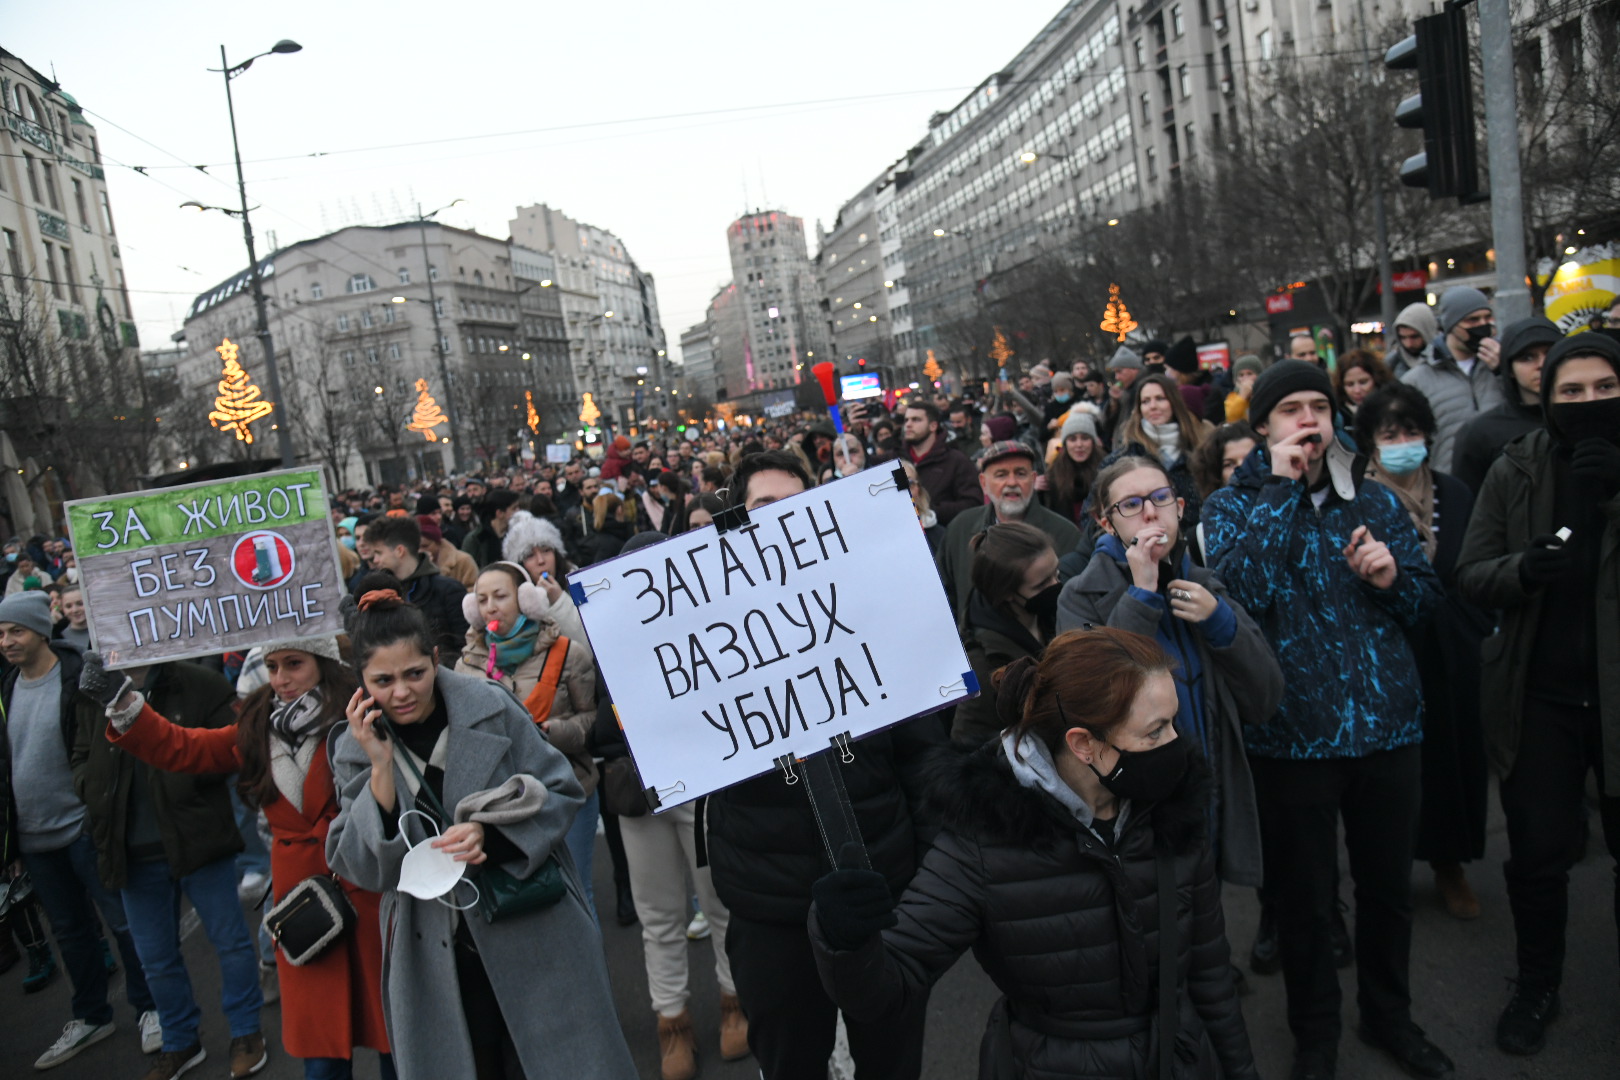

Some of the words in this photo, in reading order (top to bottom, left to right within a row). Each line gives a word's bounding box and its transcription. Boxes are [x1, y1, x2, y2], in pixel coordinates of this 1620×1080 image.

[91, 507, 151, 549] ЗА
[177, 483, 311, 535] ЖИВОТ
[130, 548, 217, 598] БЕЗ
[622, 500, 849, 625] ЗАГАЂЕН
[127, 582, 325, 647] ПУМПИЦЕ
[653, 582, 856, 700] ВАЗДУХ
[701, 642, 888, 761] УБИЈА!
